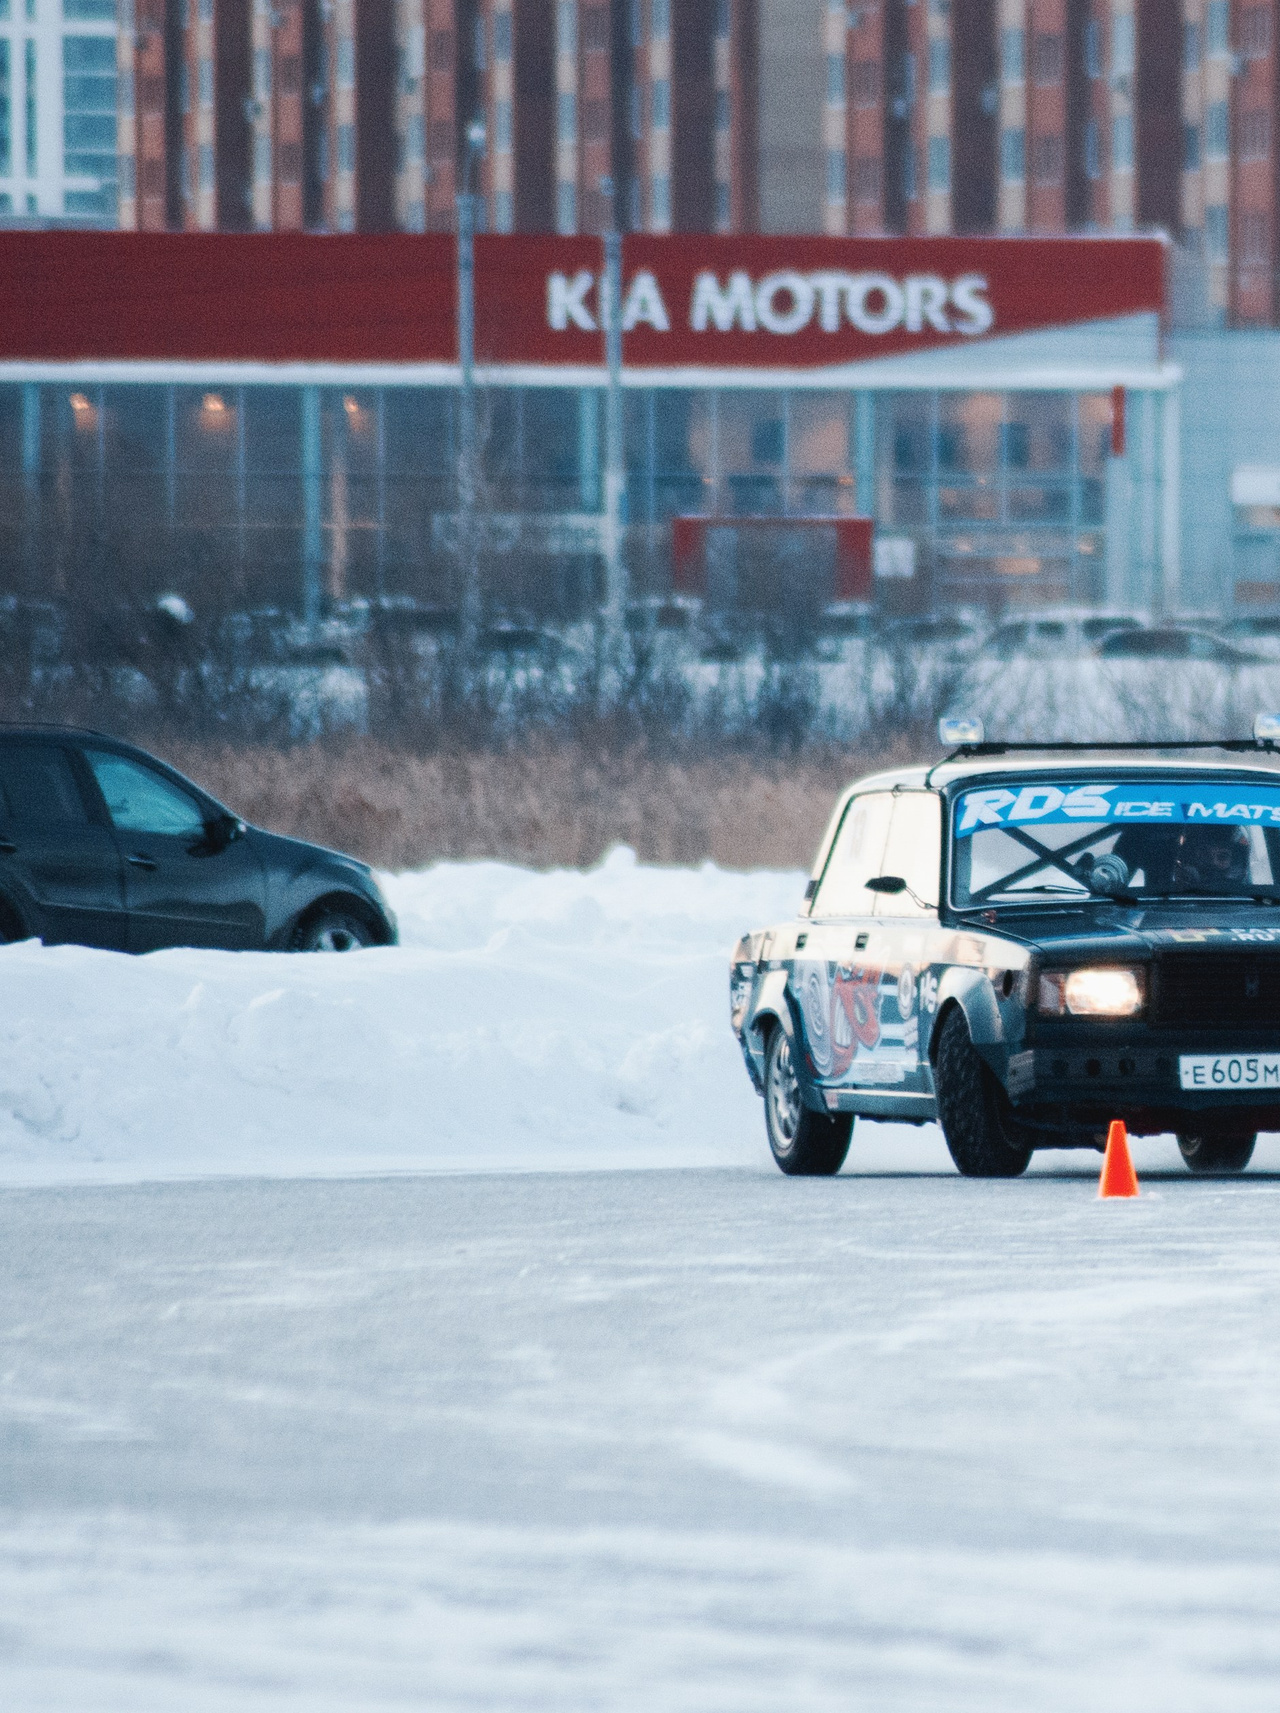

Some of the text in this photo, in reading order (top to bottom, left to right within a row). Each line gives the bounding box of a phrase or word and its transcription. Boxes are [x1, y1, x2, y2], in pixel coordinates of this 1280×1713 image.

[691, 270, 995, 334] MOTORS
[959, 785, 1119, 831] RDS
[1114, 801, 1175, 817] ICE
